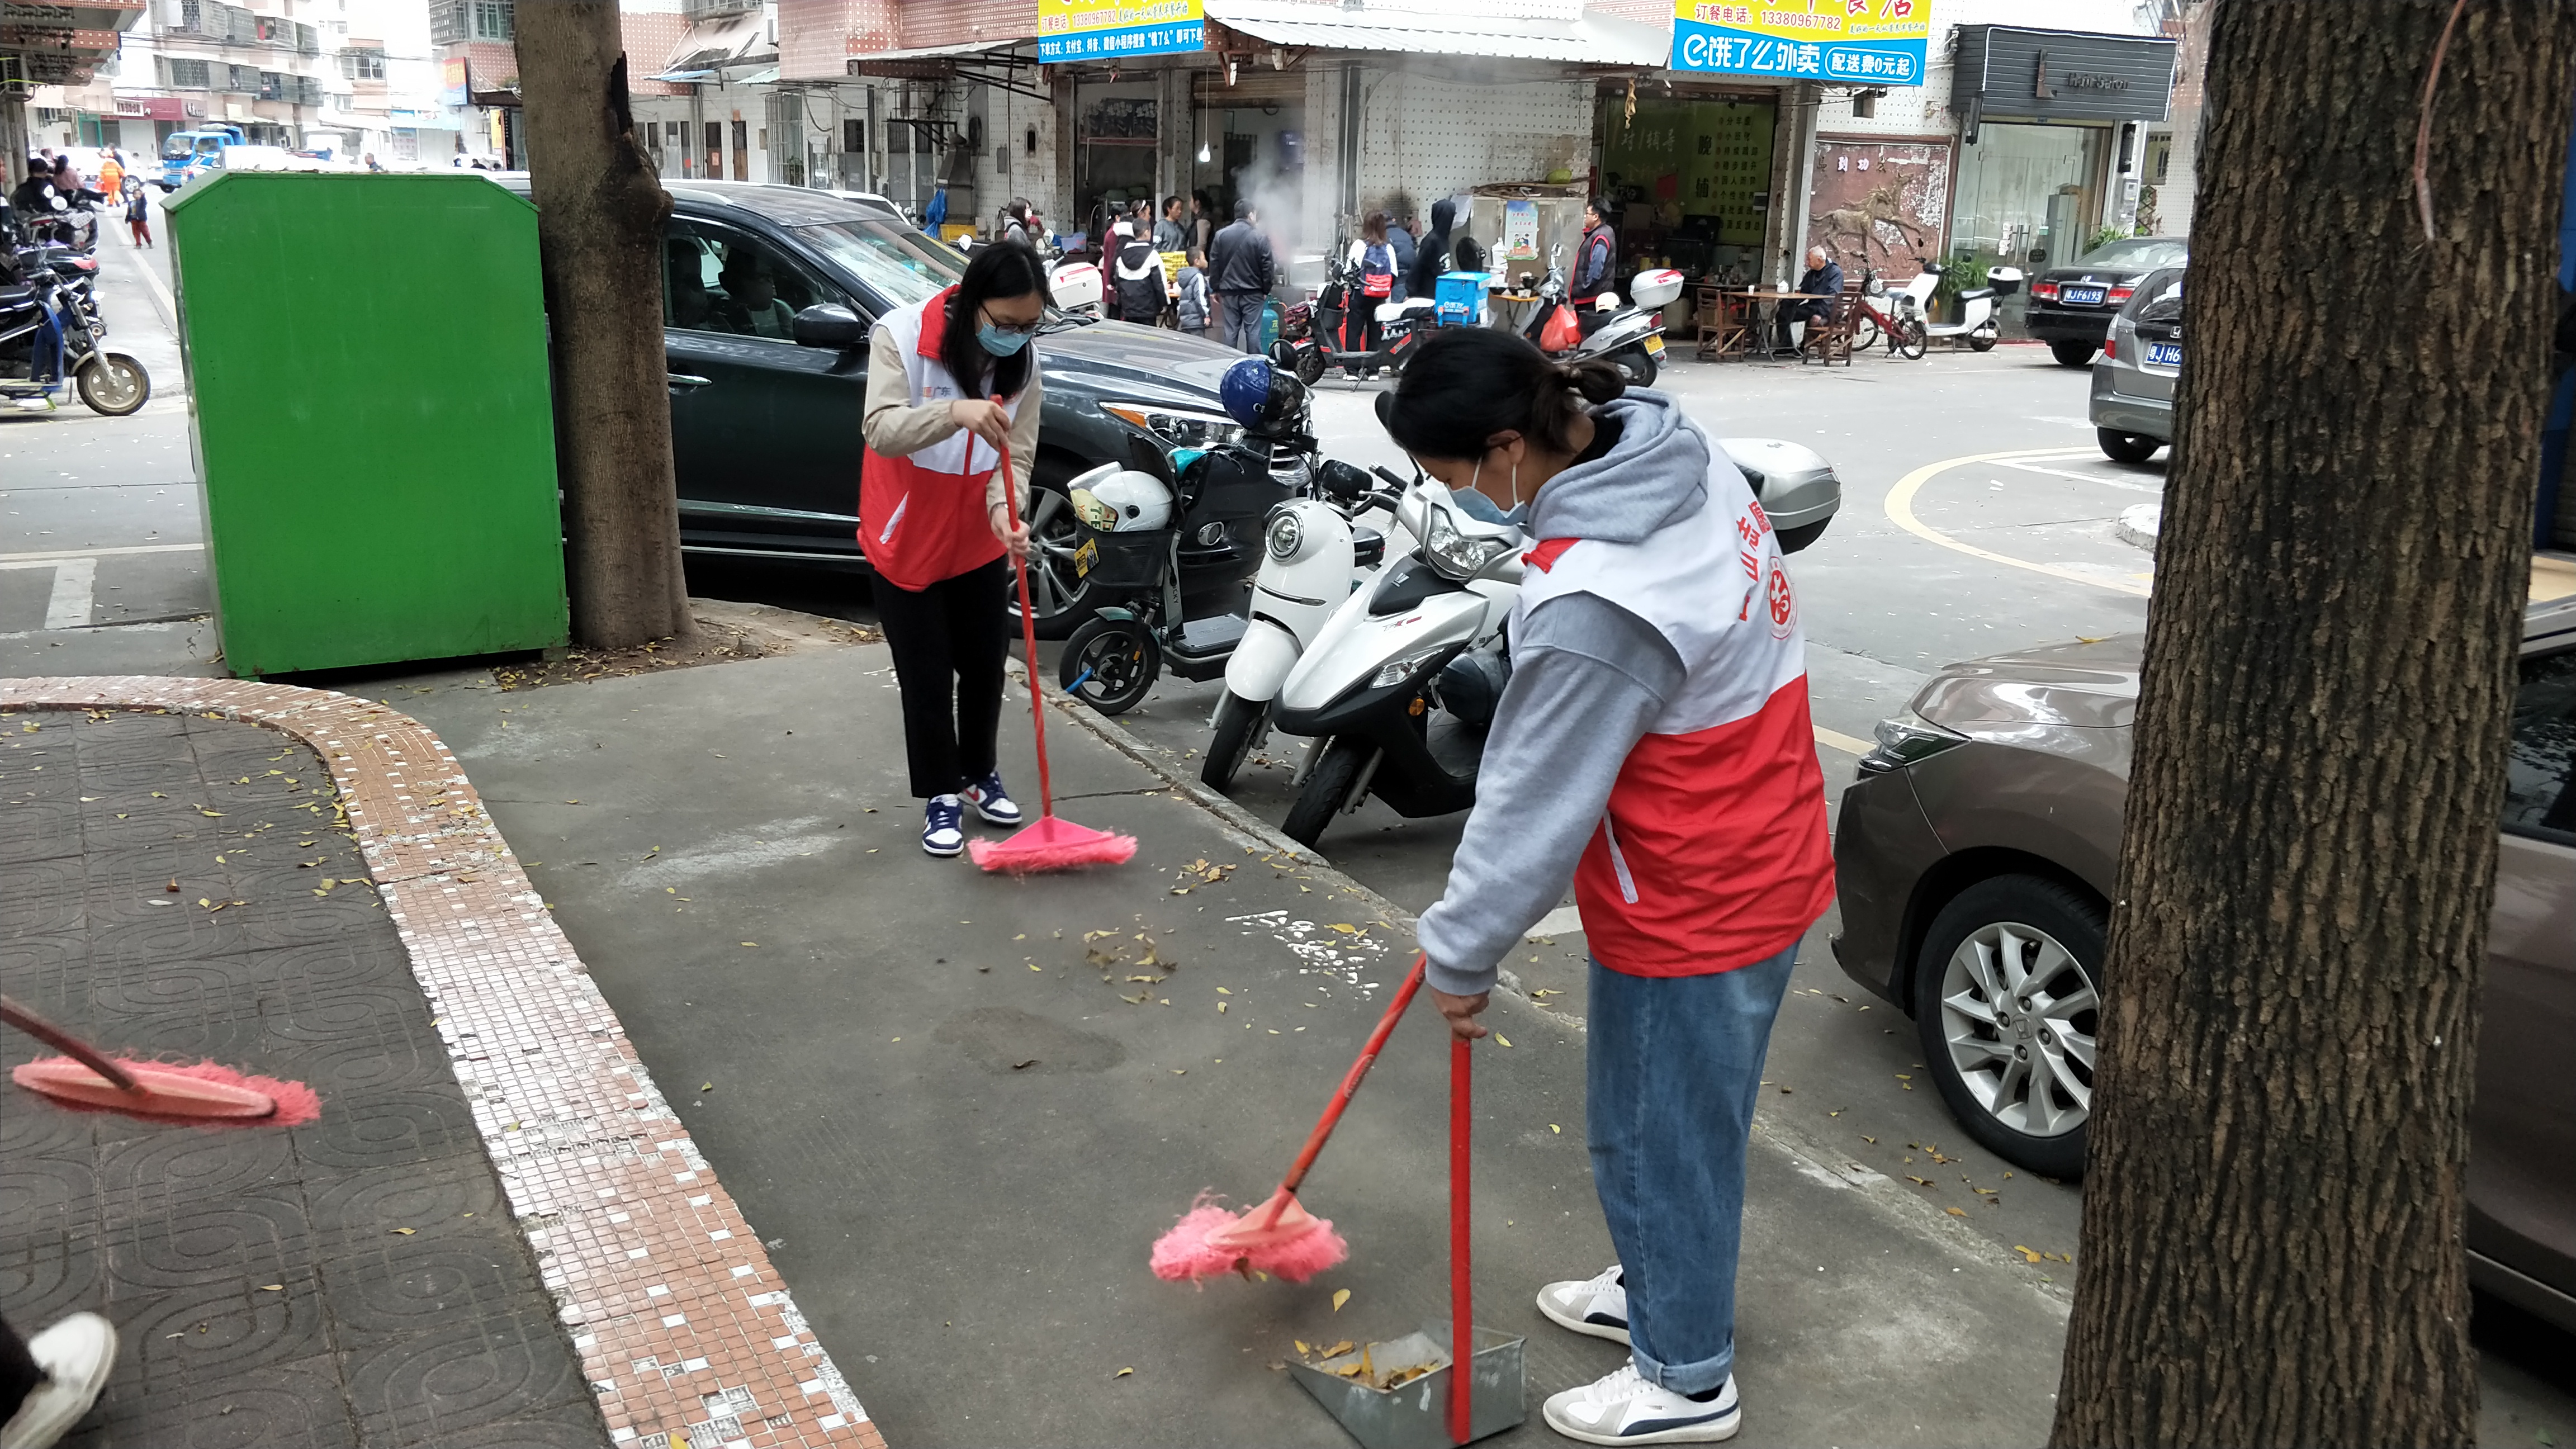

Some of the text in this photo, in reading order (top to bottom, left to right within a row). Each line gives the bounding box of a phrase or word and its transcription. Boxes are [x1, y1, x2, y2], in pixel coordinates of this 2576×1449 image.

[1073, 10, 1116, 27] 13380967782
[1761, 11, 1841, 30] 13380967782
[1832, 53, 1910, 76] 配送费0元起
[2097, 74, 2129, 90] Salon
